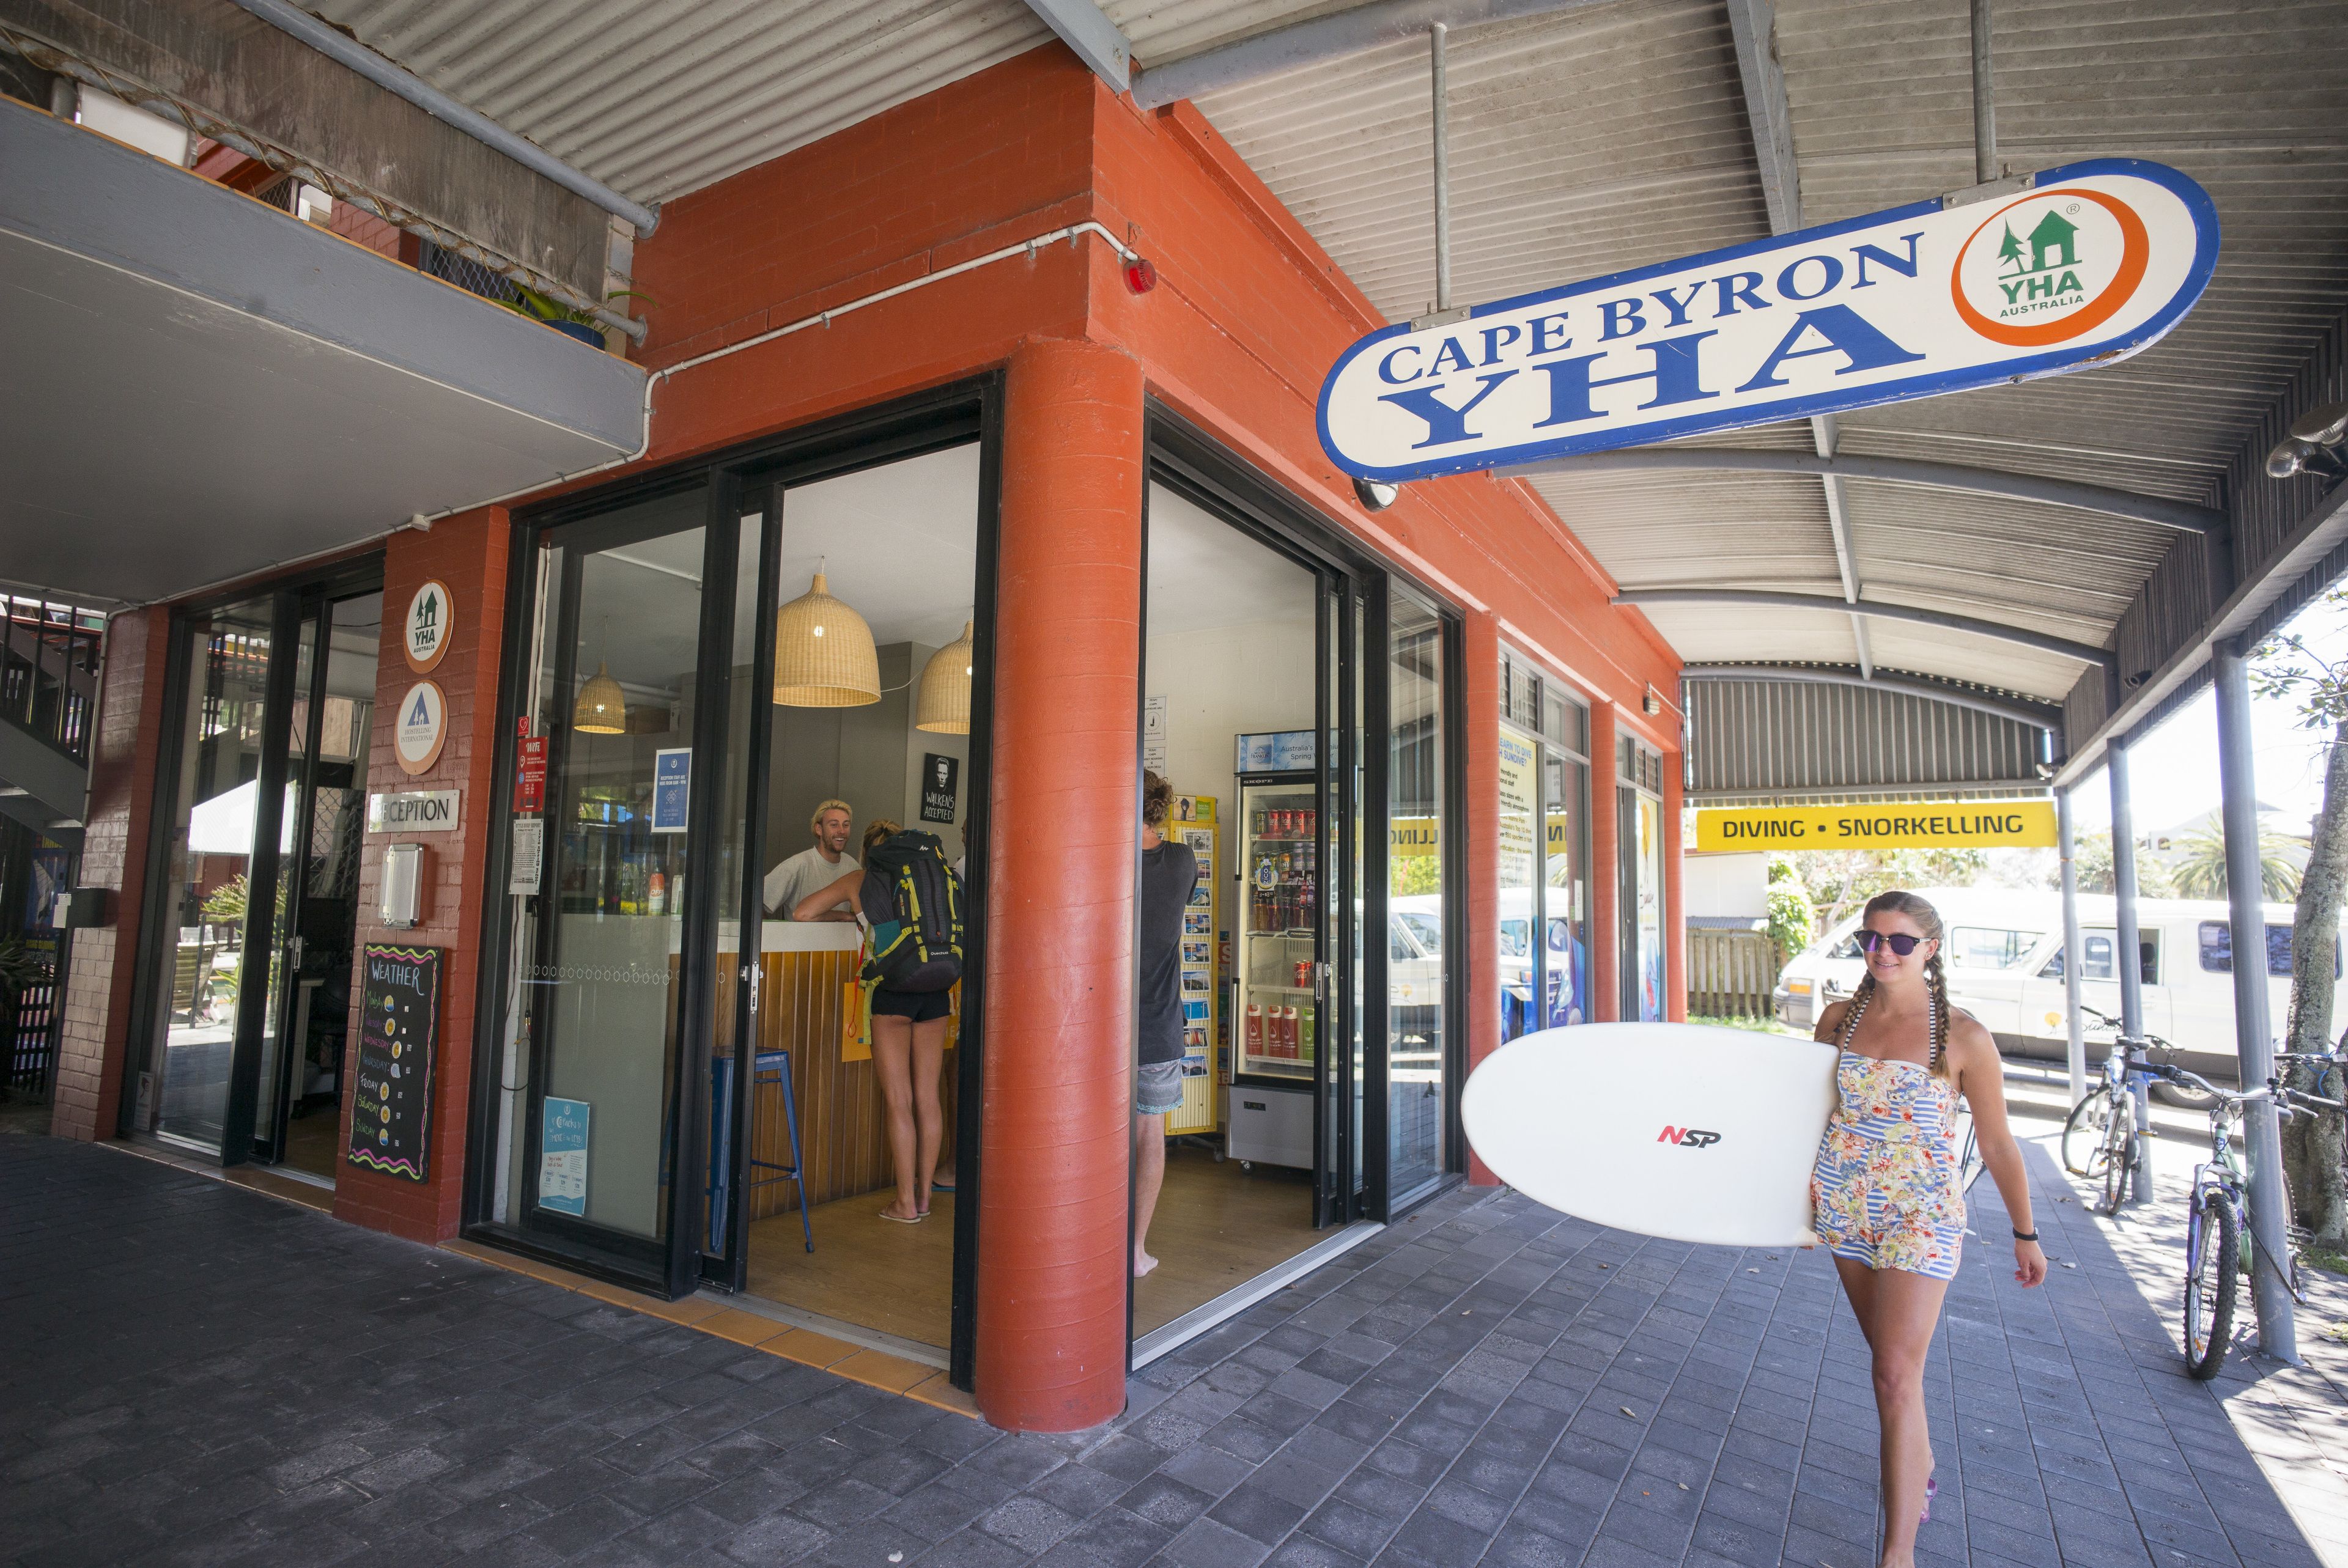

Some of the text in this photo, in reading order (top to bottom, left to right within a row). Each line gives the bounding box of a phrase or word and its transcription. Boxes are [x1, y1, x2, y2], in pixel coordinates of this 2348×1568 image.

[1998, 270, 2084, 304] YHA
[1377, 231, 1925, 385] CAPE BYRON
[1999, 295, 2084, 318] AUSTRALIA
[1376, 303, 1926, 450] YHA
[415, 628, 435, 646] YHA
[413, 644, 435, 653] AUSTRALIA
[401, 735, 434, 743] INTERNATIONAL
[405, 727, 431, 735] HOSTELLING
[526, 742, 541, 753] WiFi
[1499, 737, 1513, 751] EARN
[1515, 743, 1521, 754] TO
[1521, 747, 1532, 759] DIVE
[1504, 749, 1527, 767] SUNDIVE?
[926, 792, 954, 809] WALKENS
[925, 806, 953, 820] ACCEPTED
[1722, 814, 2024, 838] DIVING SNORKELLING
[372, 960, 424, 995] WEATHER
[1657, 1125, 1721, 1148] NSP
